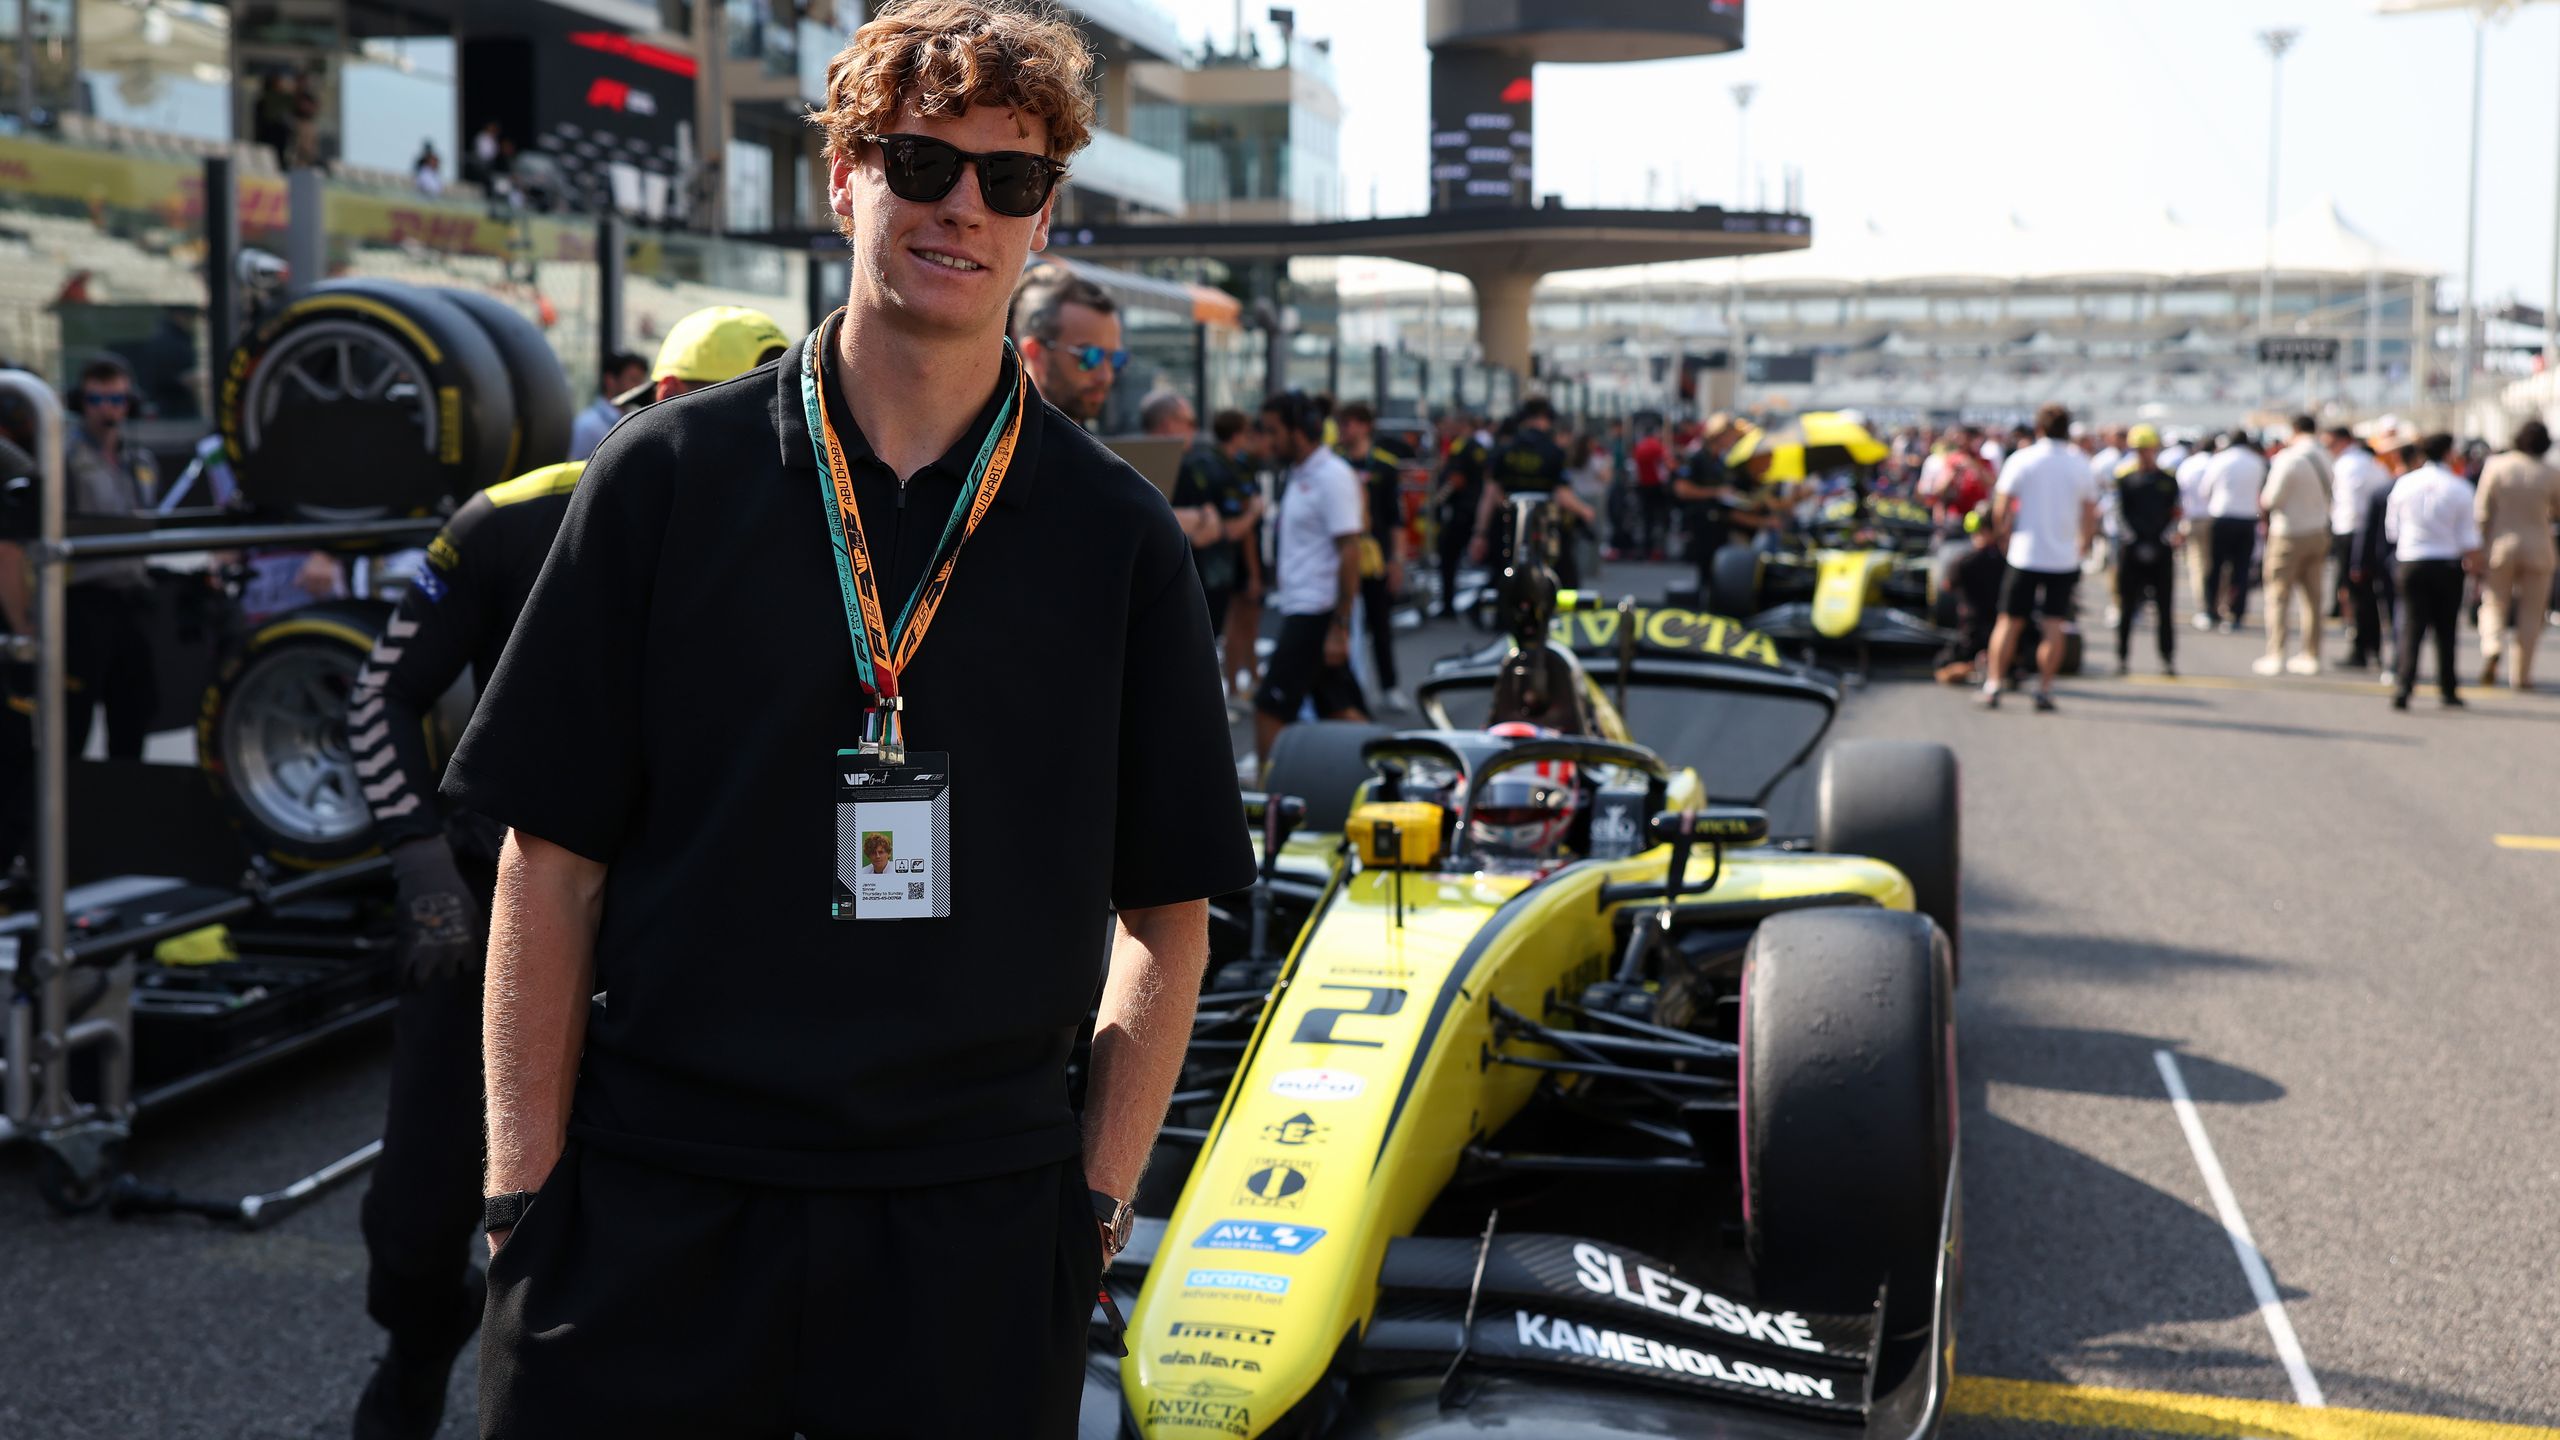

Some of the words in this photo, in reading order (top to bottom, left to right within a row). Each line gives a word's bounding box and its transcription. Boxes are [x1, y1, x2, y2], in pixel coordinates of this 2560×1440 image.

[829, 439, 847, 481] DHABI
[840, 480, 853, 506] ABU
[978, 467, 1004, 504] DHABI
[829, 498, 843, 537] SUNDAY
[970, 503, 987, 528] ABU
[852, 548, 867, 575] VIP
[933, 559, 952, 583] VIP
[842, 581, 857, 630] PADDOCK
[849, 603, 861, 630] CLUB
[843, 773, 869, 786] VIP
[1291, 984, 1408, 1049] 2
[1214, 1224, 1264, 1242] AVL
[1190, 1271, 1285, 1291] aramco
[1181, 1289, 1252, 1303] advanced
[1255, 1291, 1284, 1306] fuel
[1572, 1242, 1825, 1353] SLEZSKÉ
[1168, 1321, 1276, 1346] PIRELLI
[1158, 1350, 1262, 1373] dallara
[1515, 1309, 1836, 1400] KAMENOLOMY
[1146, 1399, 1251, 1426] INVICTA
